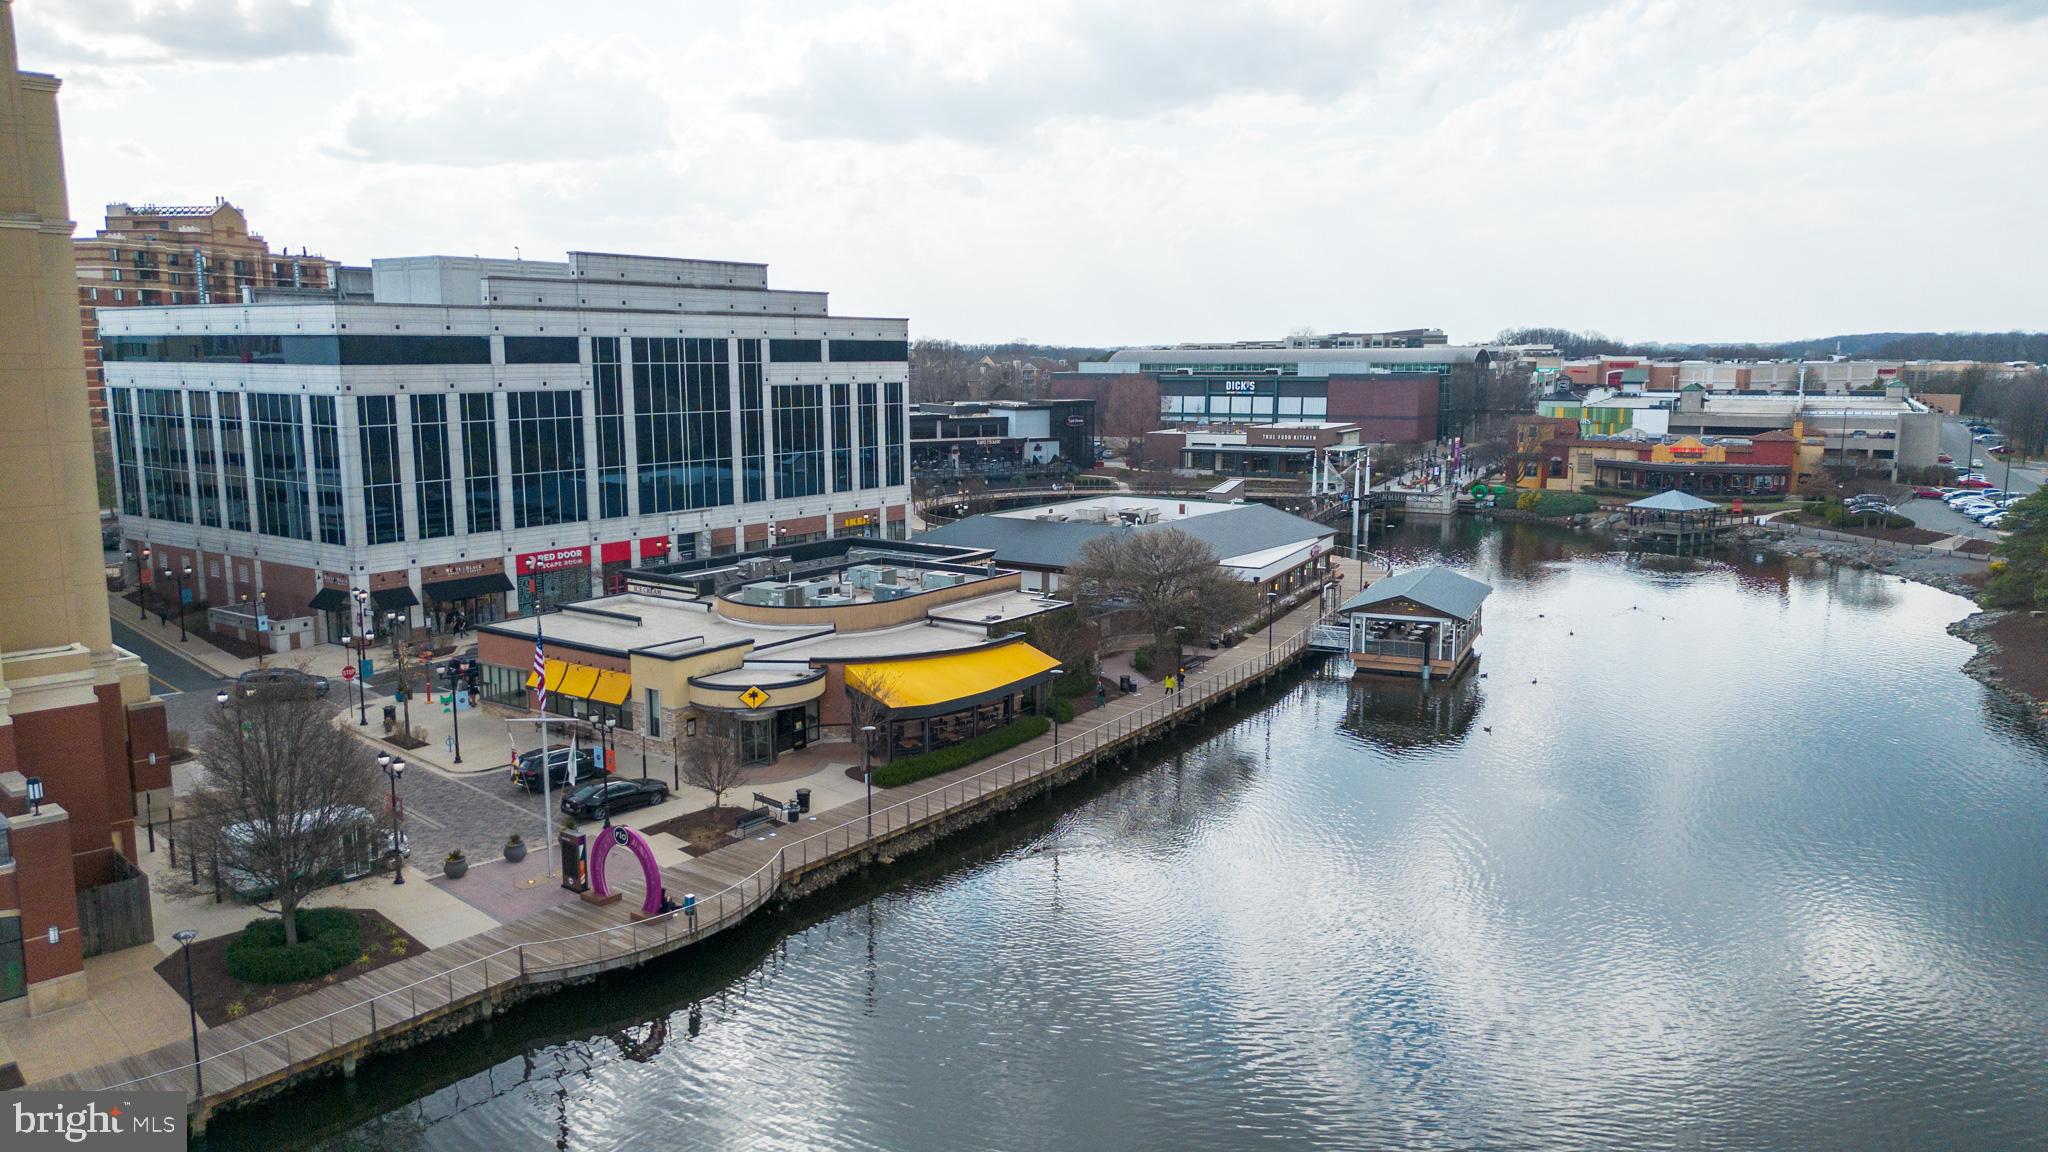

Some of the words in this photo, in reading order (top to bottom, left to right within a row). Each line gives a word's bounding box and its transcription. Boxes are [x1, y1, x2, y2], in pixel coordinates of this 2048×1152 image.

[1226, 381, 1255, 390] DICK'S
[557, 550, 582, 559] DOOR
[615, 831, 627, 840] rio
